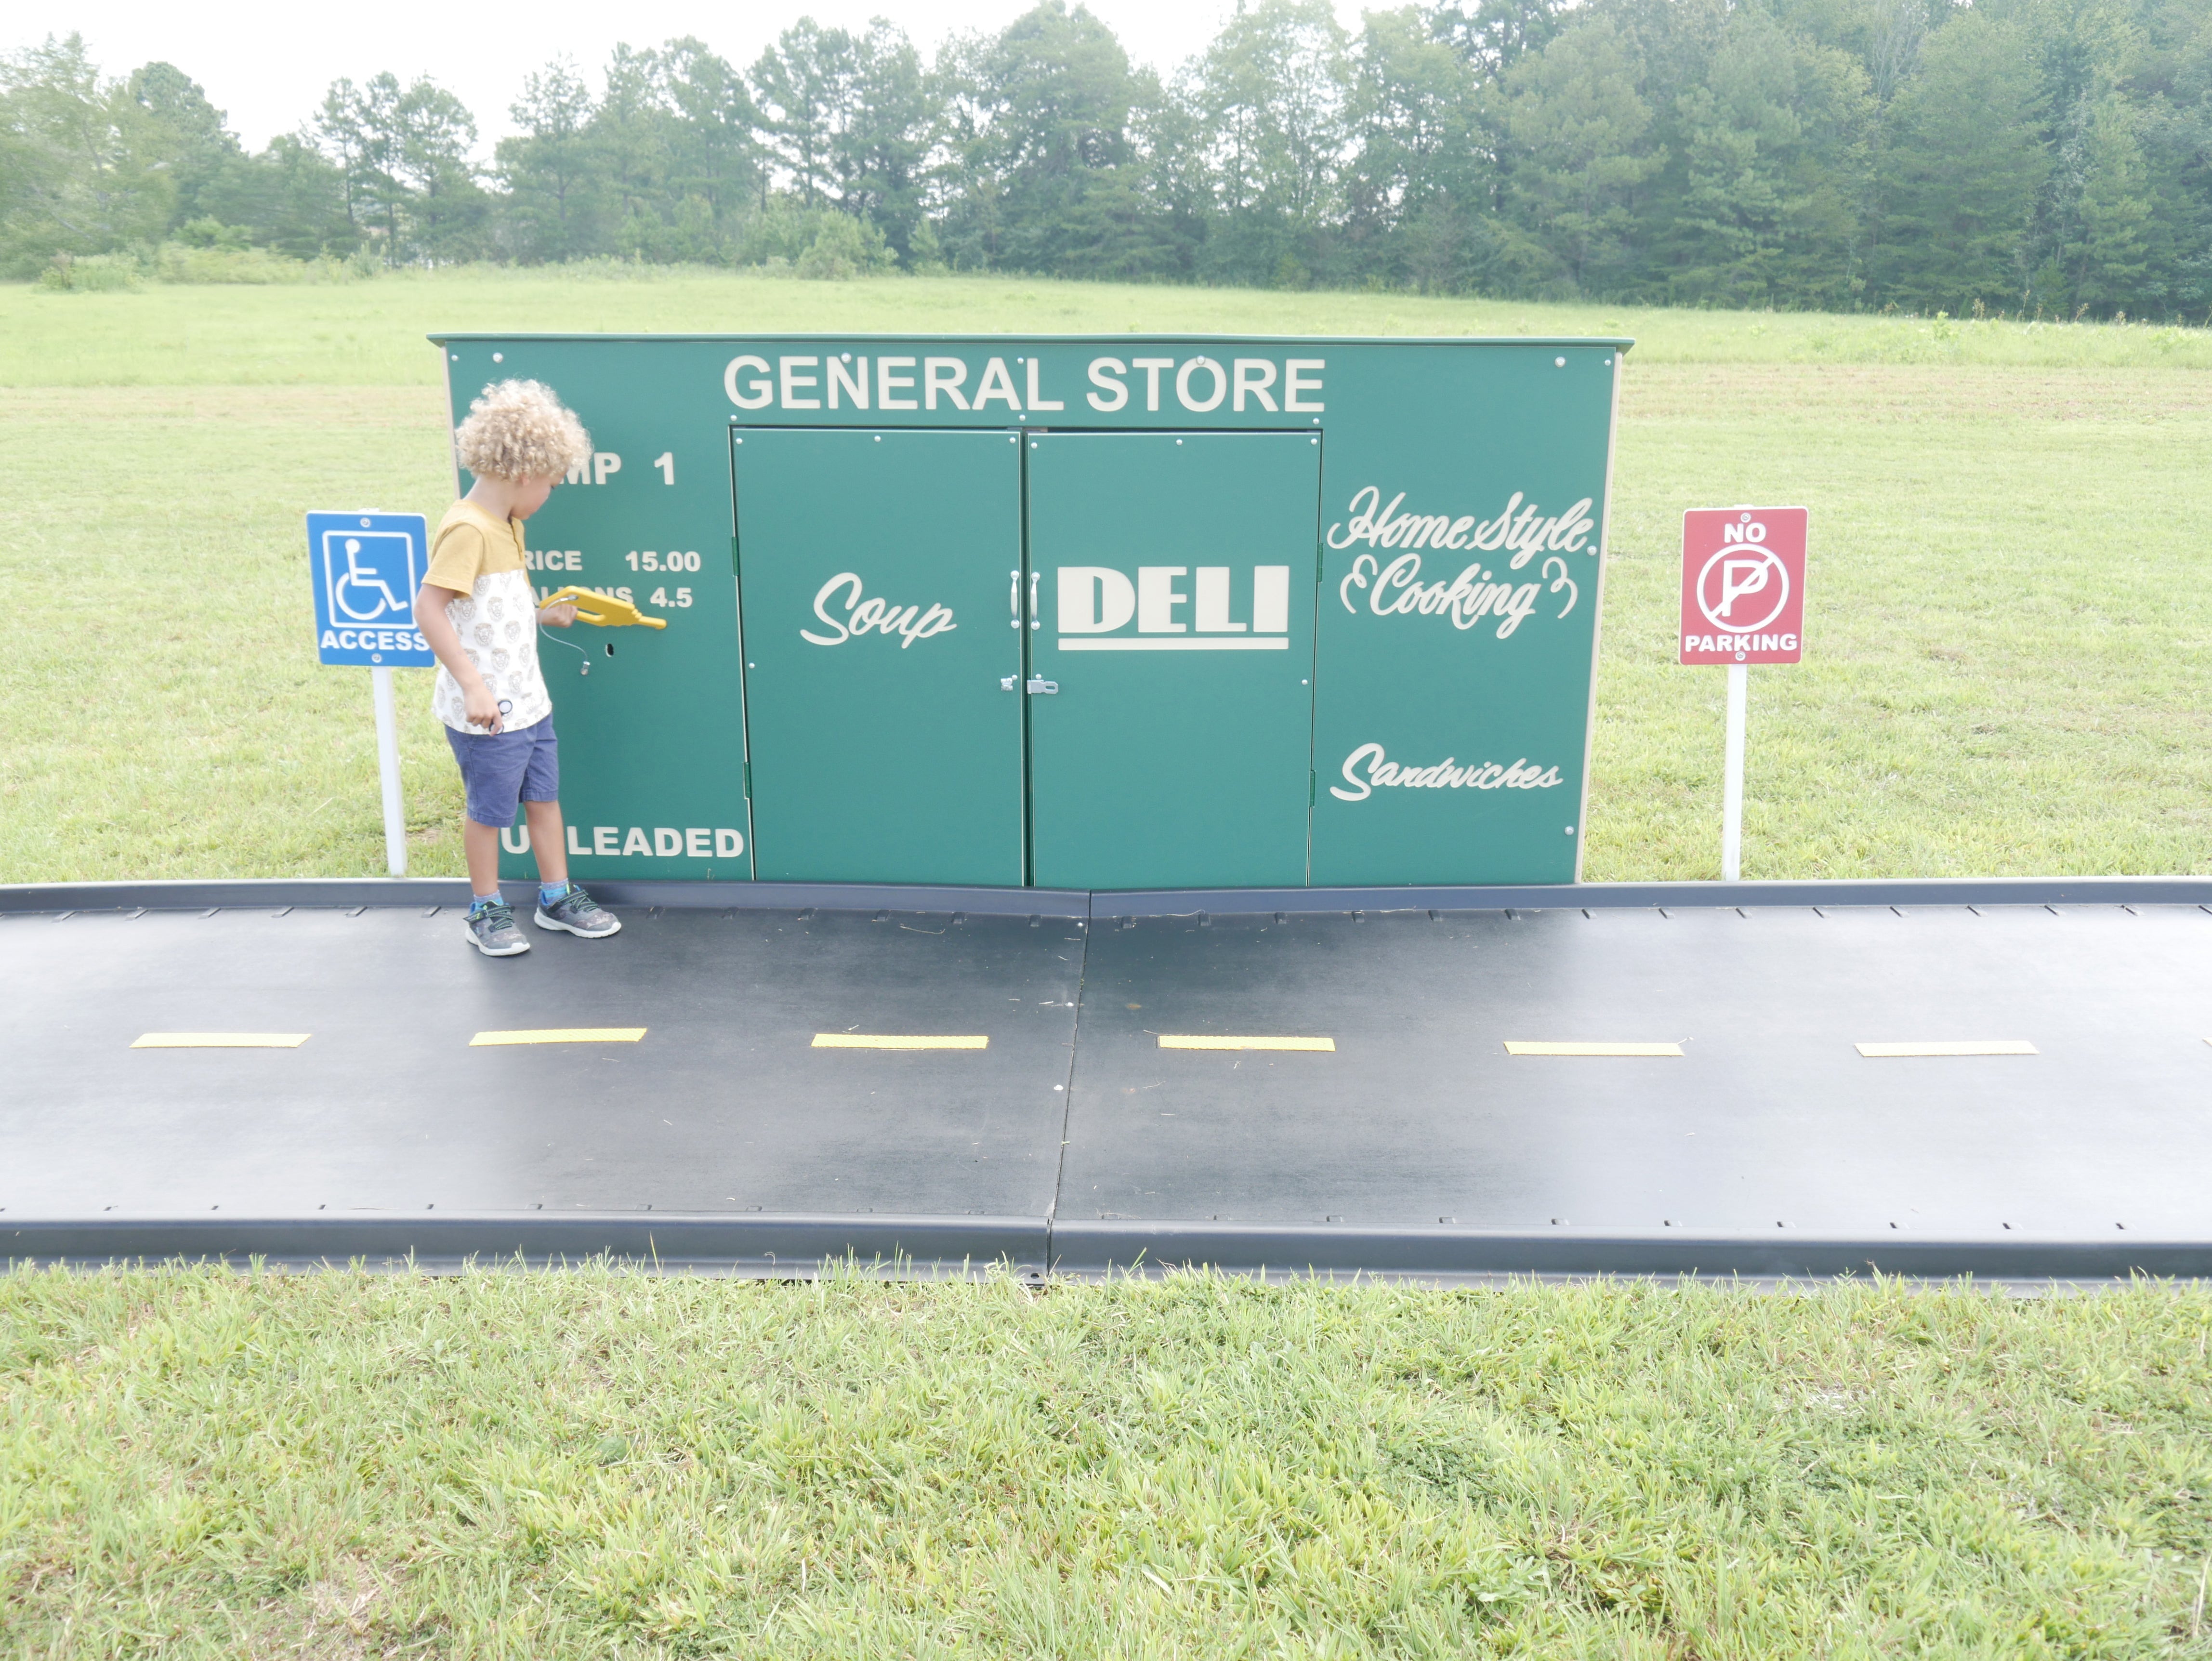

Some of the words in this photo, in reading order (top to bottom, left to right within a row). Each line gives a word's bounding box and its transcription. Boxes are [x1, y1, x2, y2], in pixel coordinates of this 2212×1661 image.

[724, 355, 1064, 410] GENERAL
[1086, 356, 1326, 412] STORE
[654, 452, 674, 485] 1
[1724, 523, 1766, 543] NO
[525, 550, 583, 571] RICE
[625, 551, 701, 572] 15.00
[650, 587, 693, 607] 4.5
[800, 572, 957, 649] Soup
[1057, 566, 1290, 633] DELI
[1370, 553, 1541, 639] Cooking
[320, 630, 431, 651] ACCESS
[1685, 633, 1797, 652] PARKING
[1330, 743, 1564, 801] Sandwiches
[500, 825, 744, 857] ULEADED
